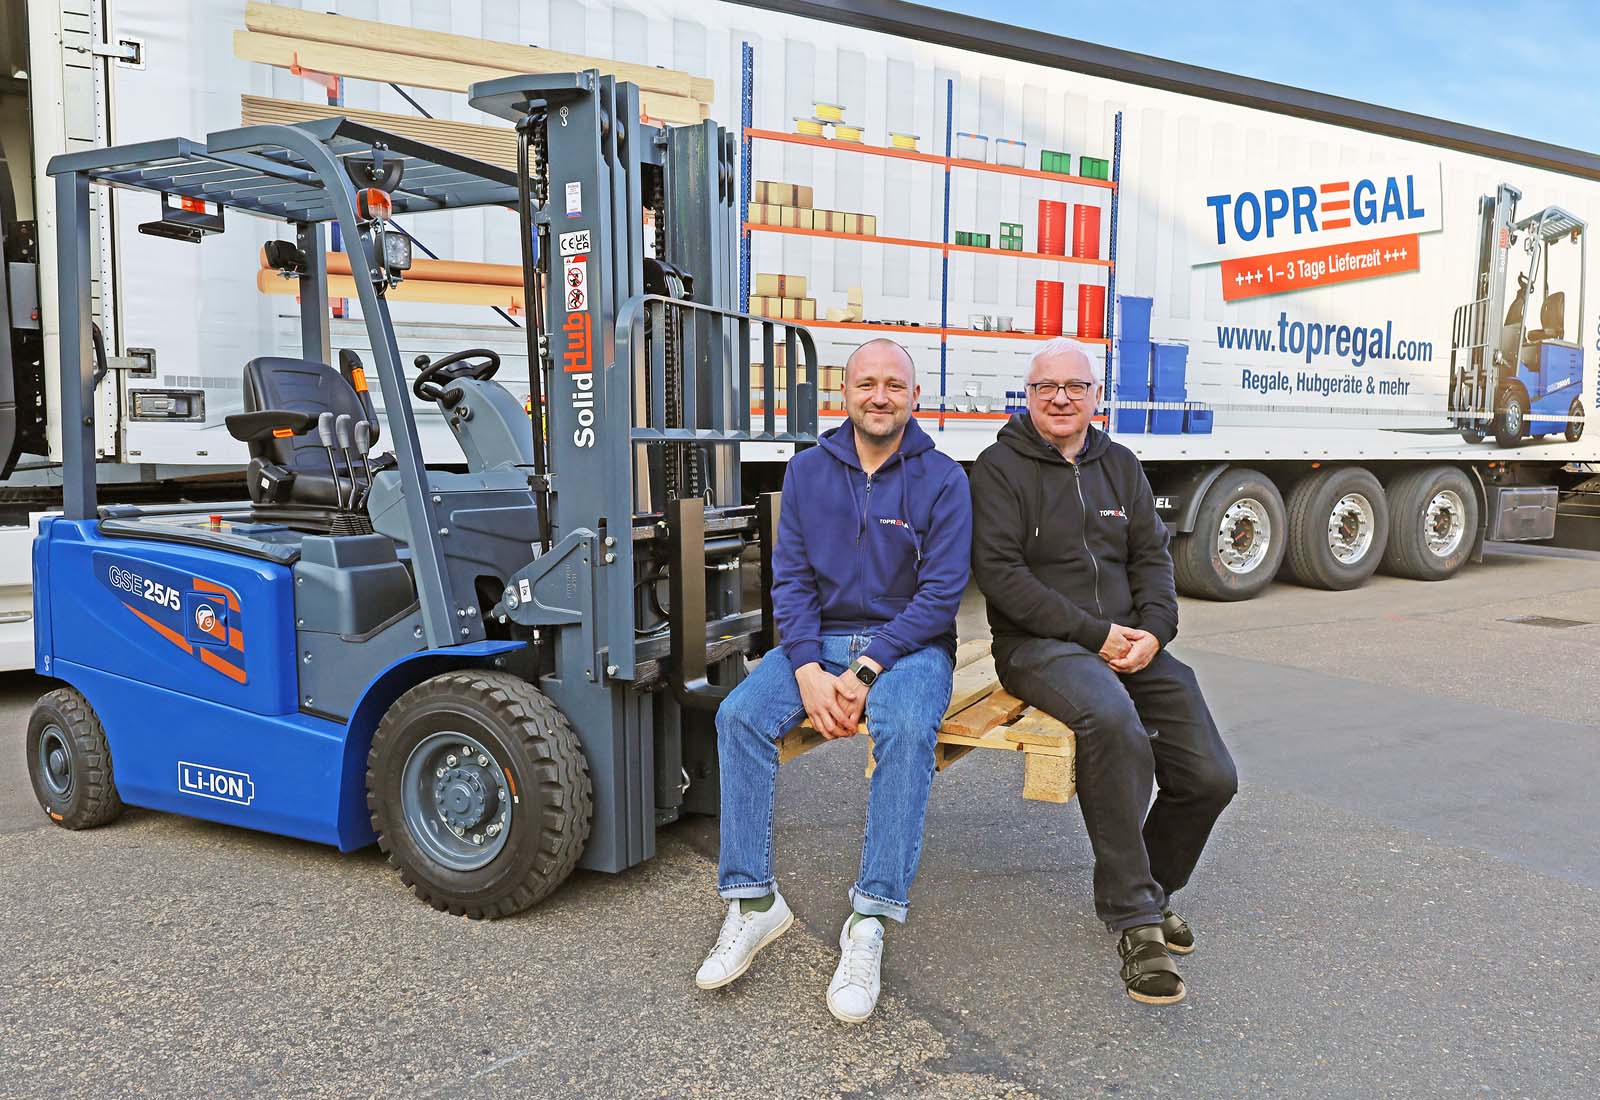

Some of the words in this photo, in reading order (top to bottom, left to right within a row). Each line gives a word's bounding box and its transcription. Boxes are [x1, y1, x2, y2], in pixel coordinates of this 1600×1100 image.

[1206, 174, 1425, 245] TOPREGAL
[575, 233, 588, 242] UK
[576, 241, 590, 251] CA
[1297, 258, 1327, 280] Tage
[1328, 248, 1381, 274] Lieferzeit
[1217, 312, 1433, 367] www.topregal.com
[1242, 369, 1293, 394] Regale,
[1297, 371, 1363, 397] Hubgeräte
[1366, 376, 1375, 394] &
[1379, 378, 1410, 396] mehr
[108, 565, 143, 597] GSE
[143, 579, 181, 611] 25/5
